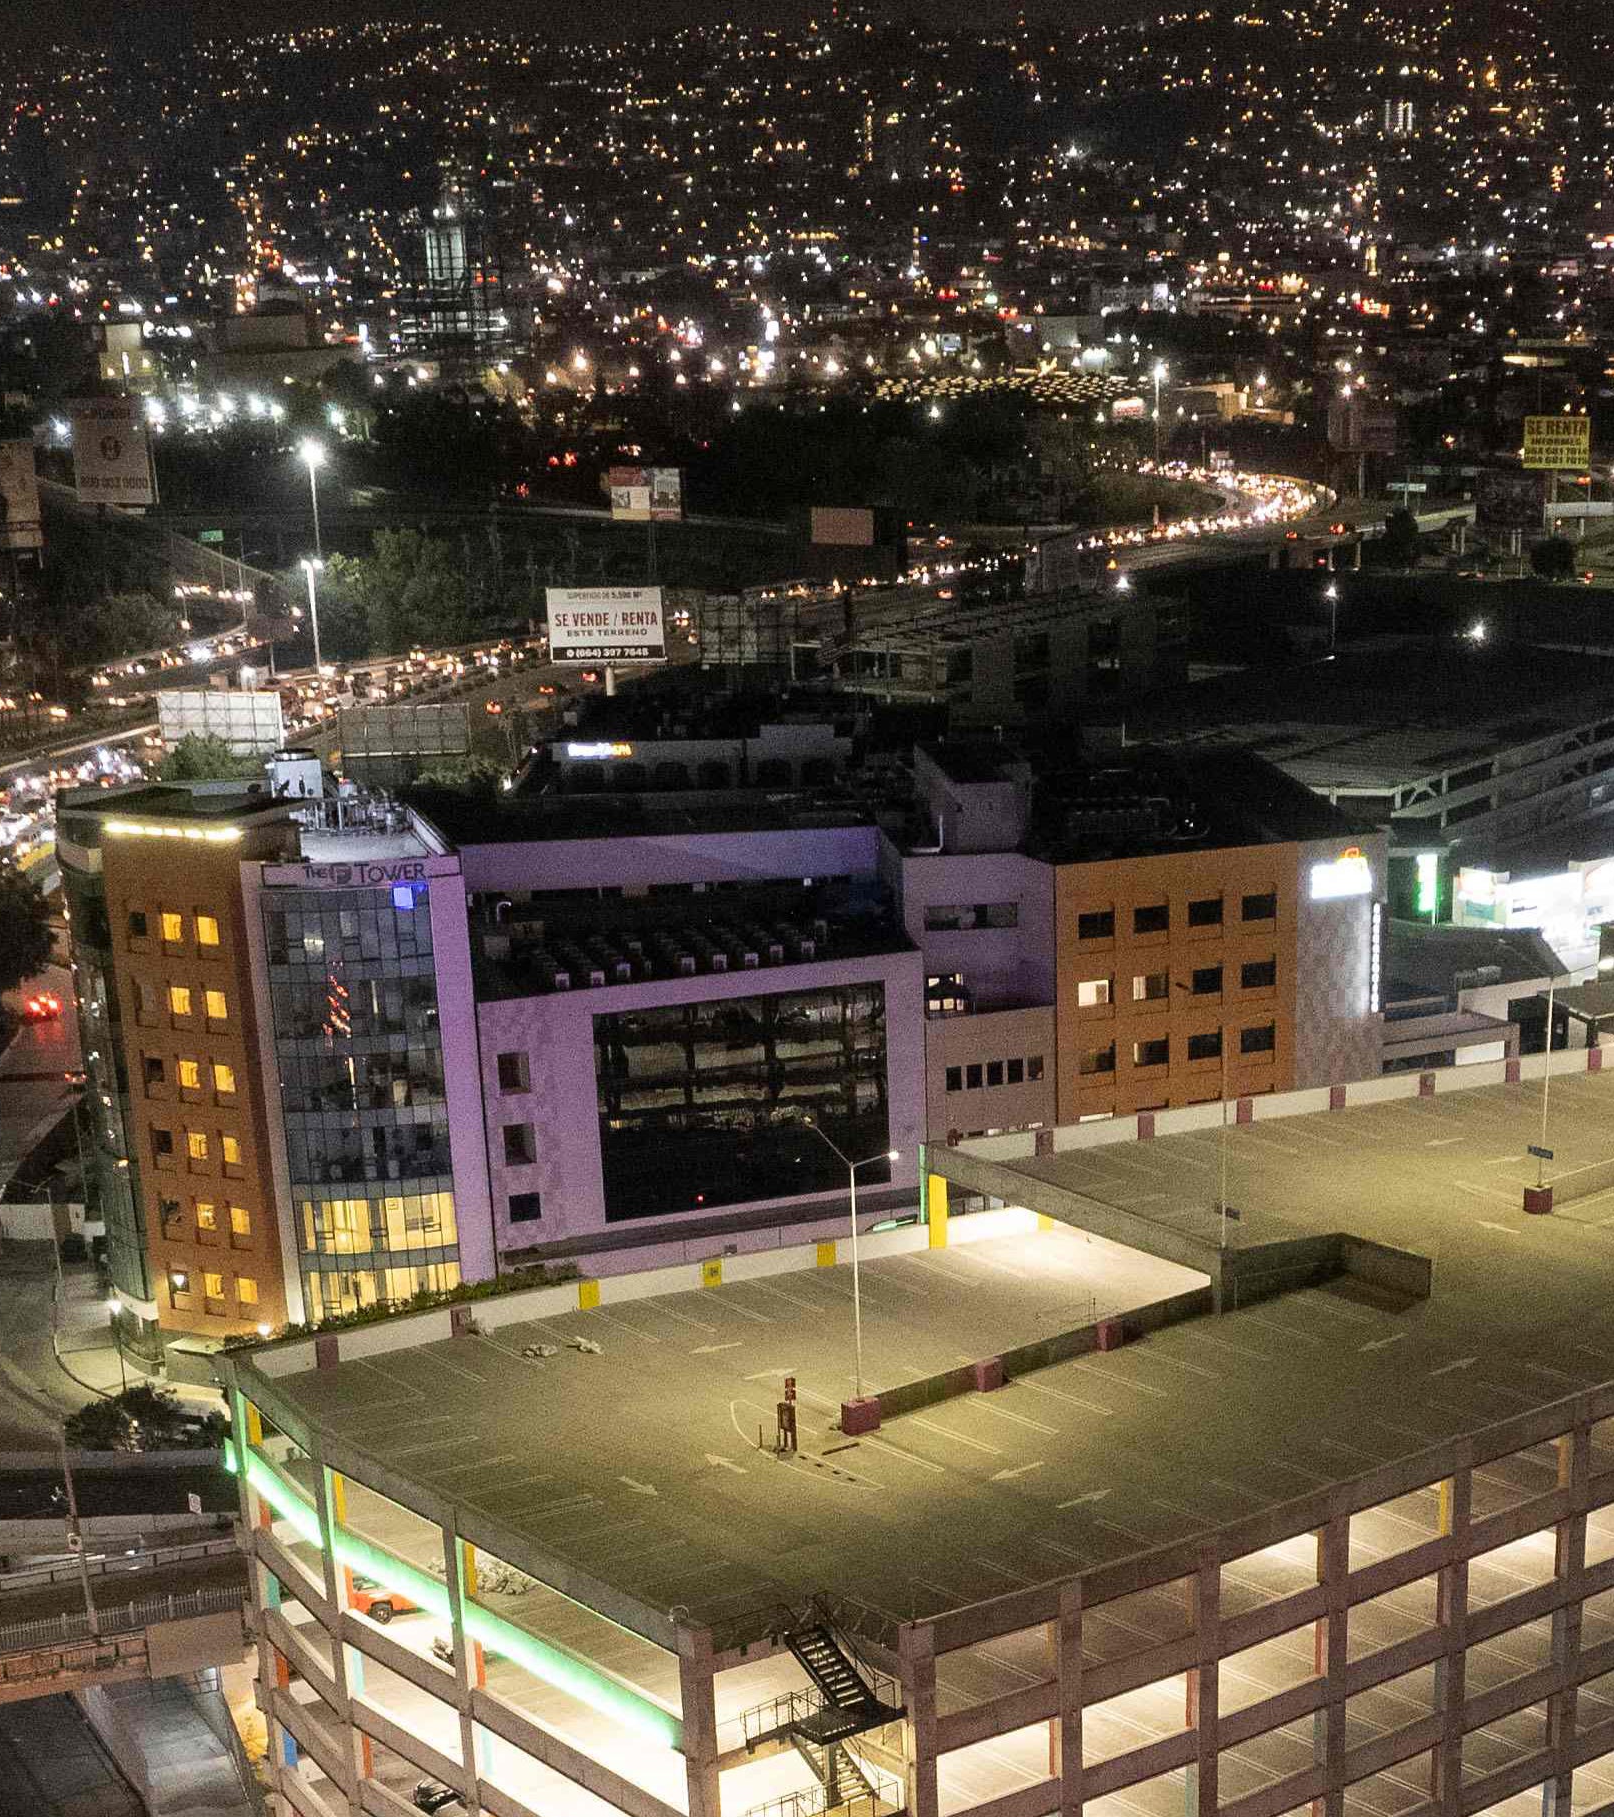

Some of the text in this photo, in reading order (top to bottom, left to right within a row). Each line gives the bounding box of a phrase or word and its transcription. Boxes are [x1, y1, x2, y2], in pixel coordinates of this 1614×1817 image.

[554, 613, 570, 627] SE
[572, 612, 610, 627] VENDE
[621, 611, 658, 626] RENTA
[567, 628, 648, 637] ESTE TERRENO
[354, 863, 427, 883] TOWER
